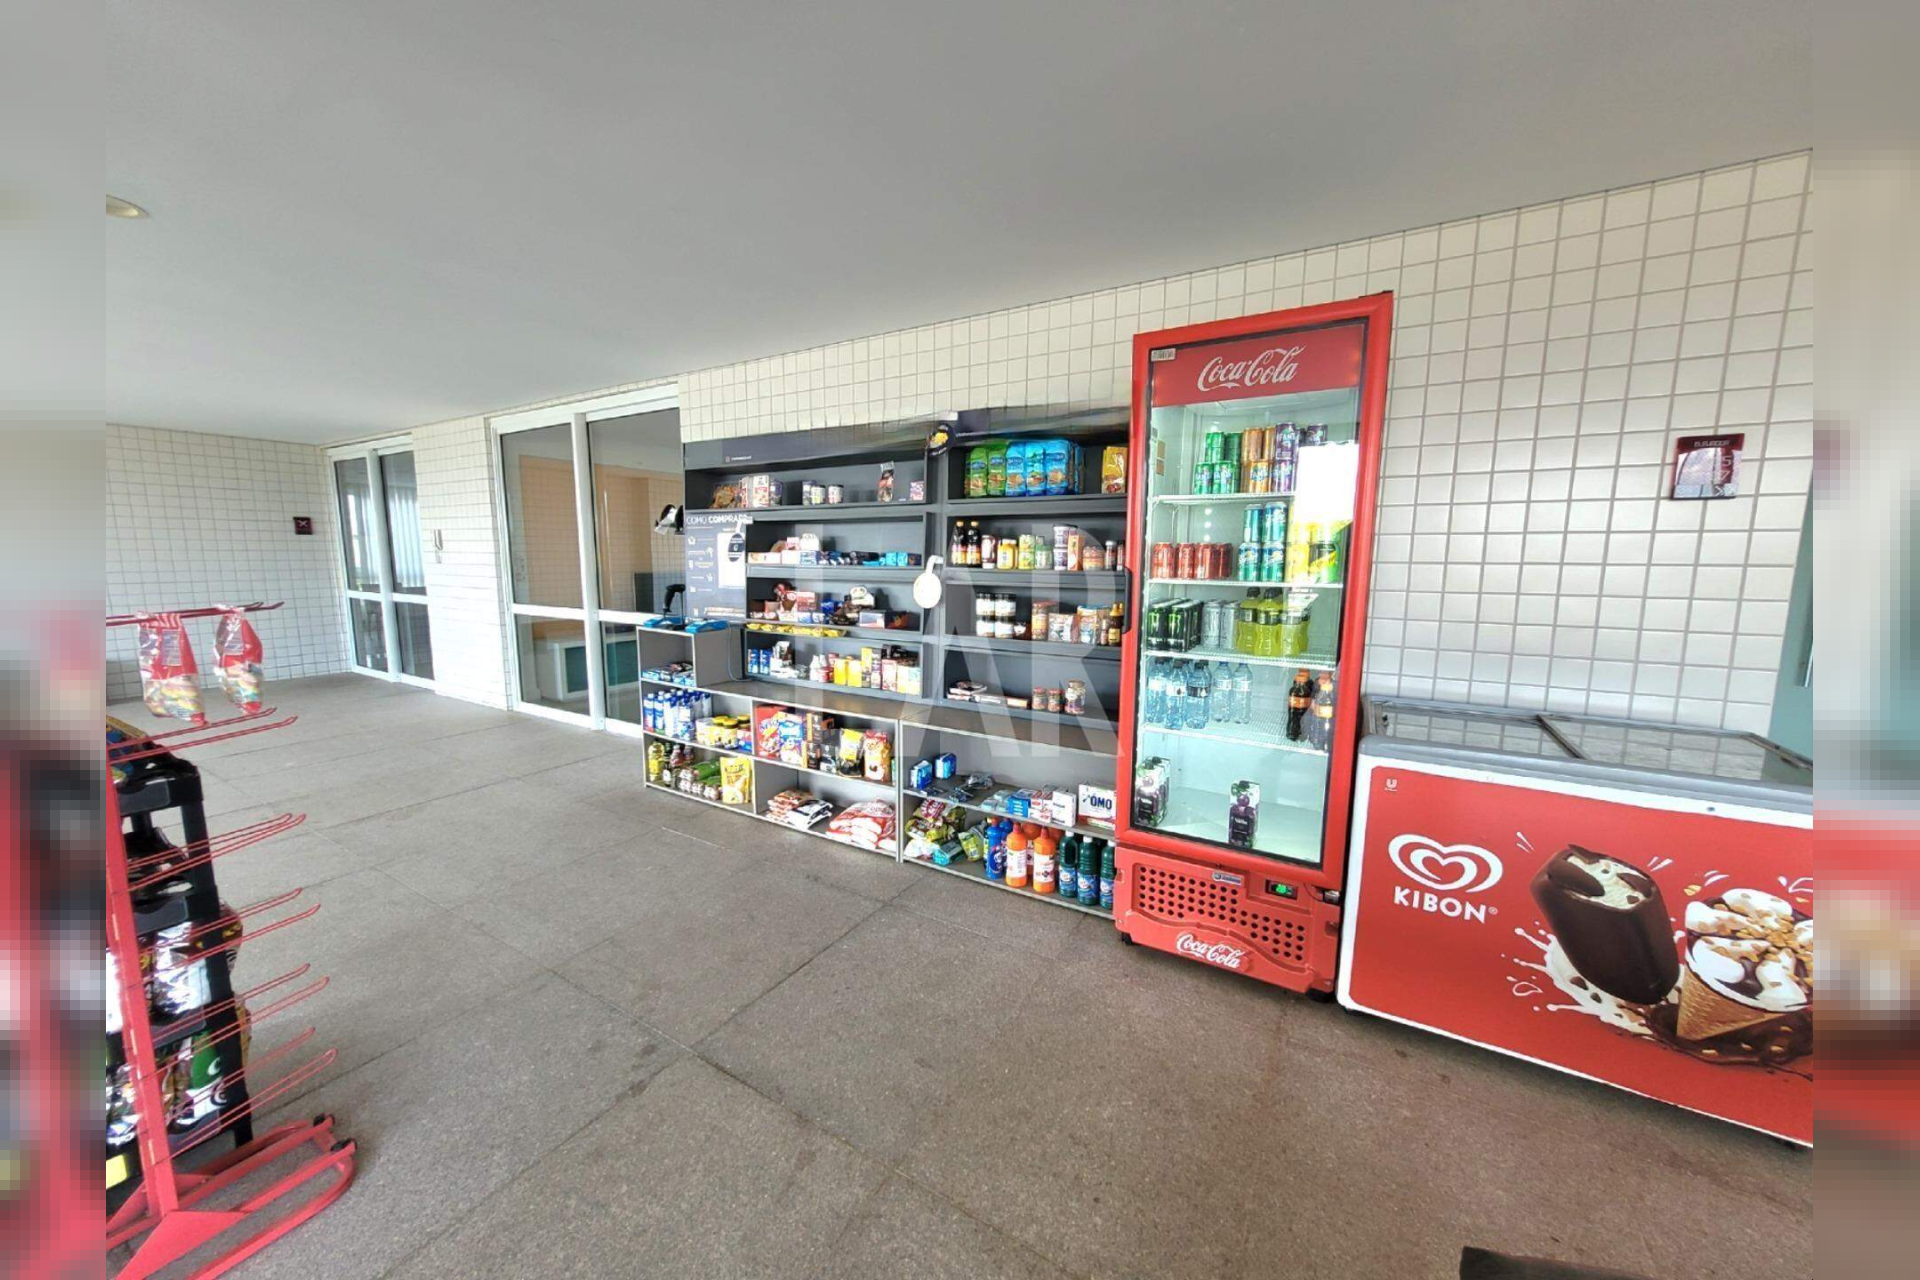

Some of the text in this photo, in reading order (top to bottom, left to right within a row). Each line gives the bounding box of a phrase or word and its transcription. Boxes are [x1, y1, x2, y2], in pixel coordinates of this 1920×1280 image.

[1197, 345, 1307, 391] Coca-Cola
[1090, 794, 1112, 811] OMO
[1393, 885, 1487, 924] KIBON
[1176, 933, 1246, 969] Coca-Cola
